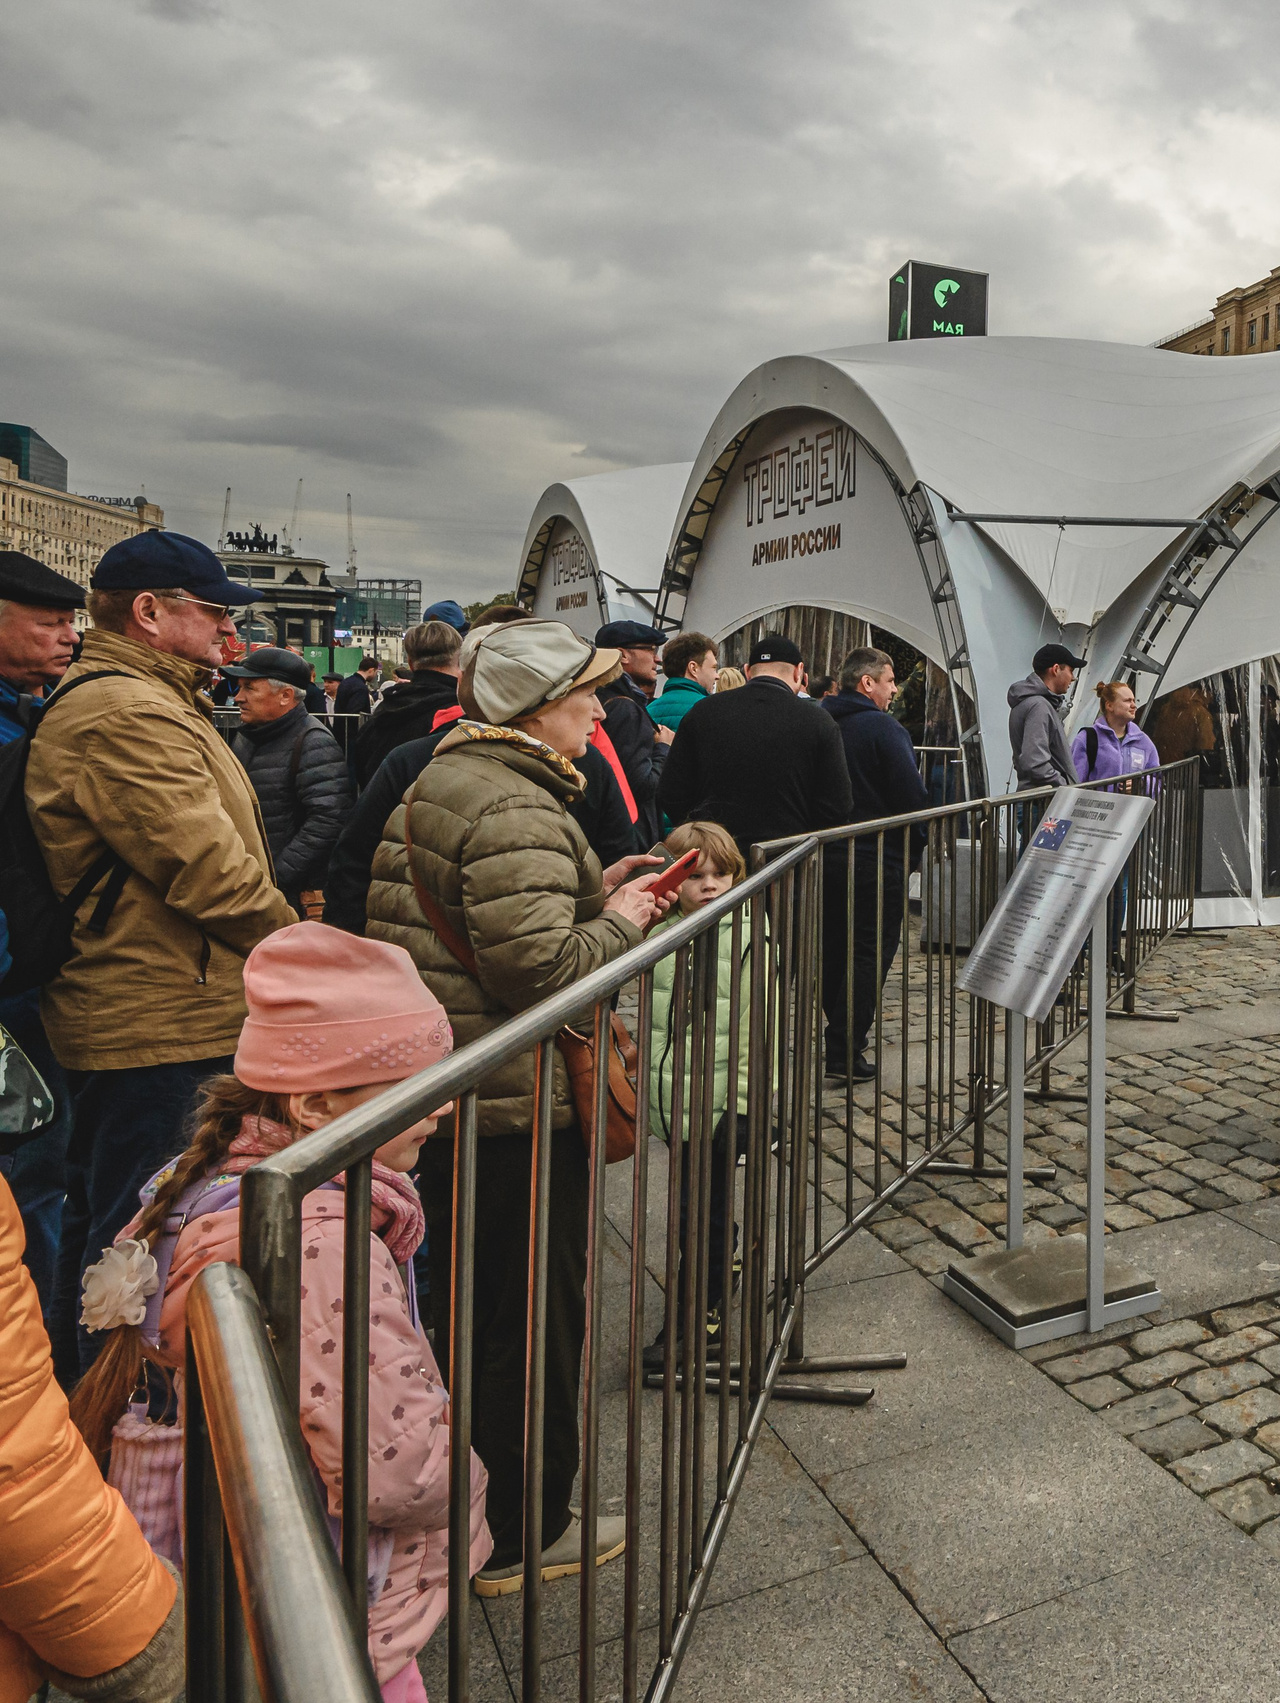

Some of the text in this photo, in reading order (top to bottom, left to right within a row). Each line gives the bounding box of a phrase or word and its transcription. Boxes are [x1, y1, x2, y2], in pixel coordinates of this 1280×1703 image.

[933, 320, 964, 336] МАЯ
[744, 425, 857, 528] ТРОФЕИ
[752, 523, 841, 567] АРМИИ РОССИИ
